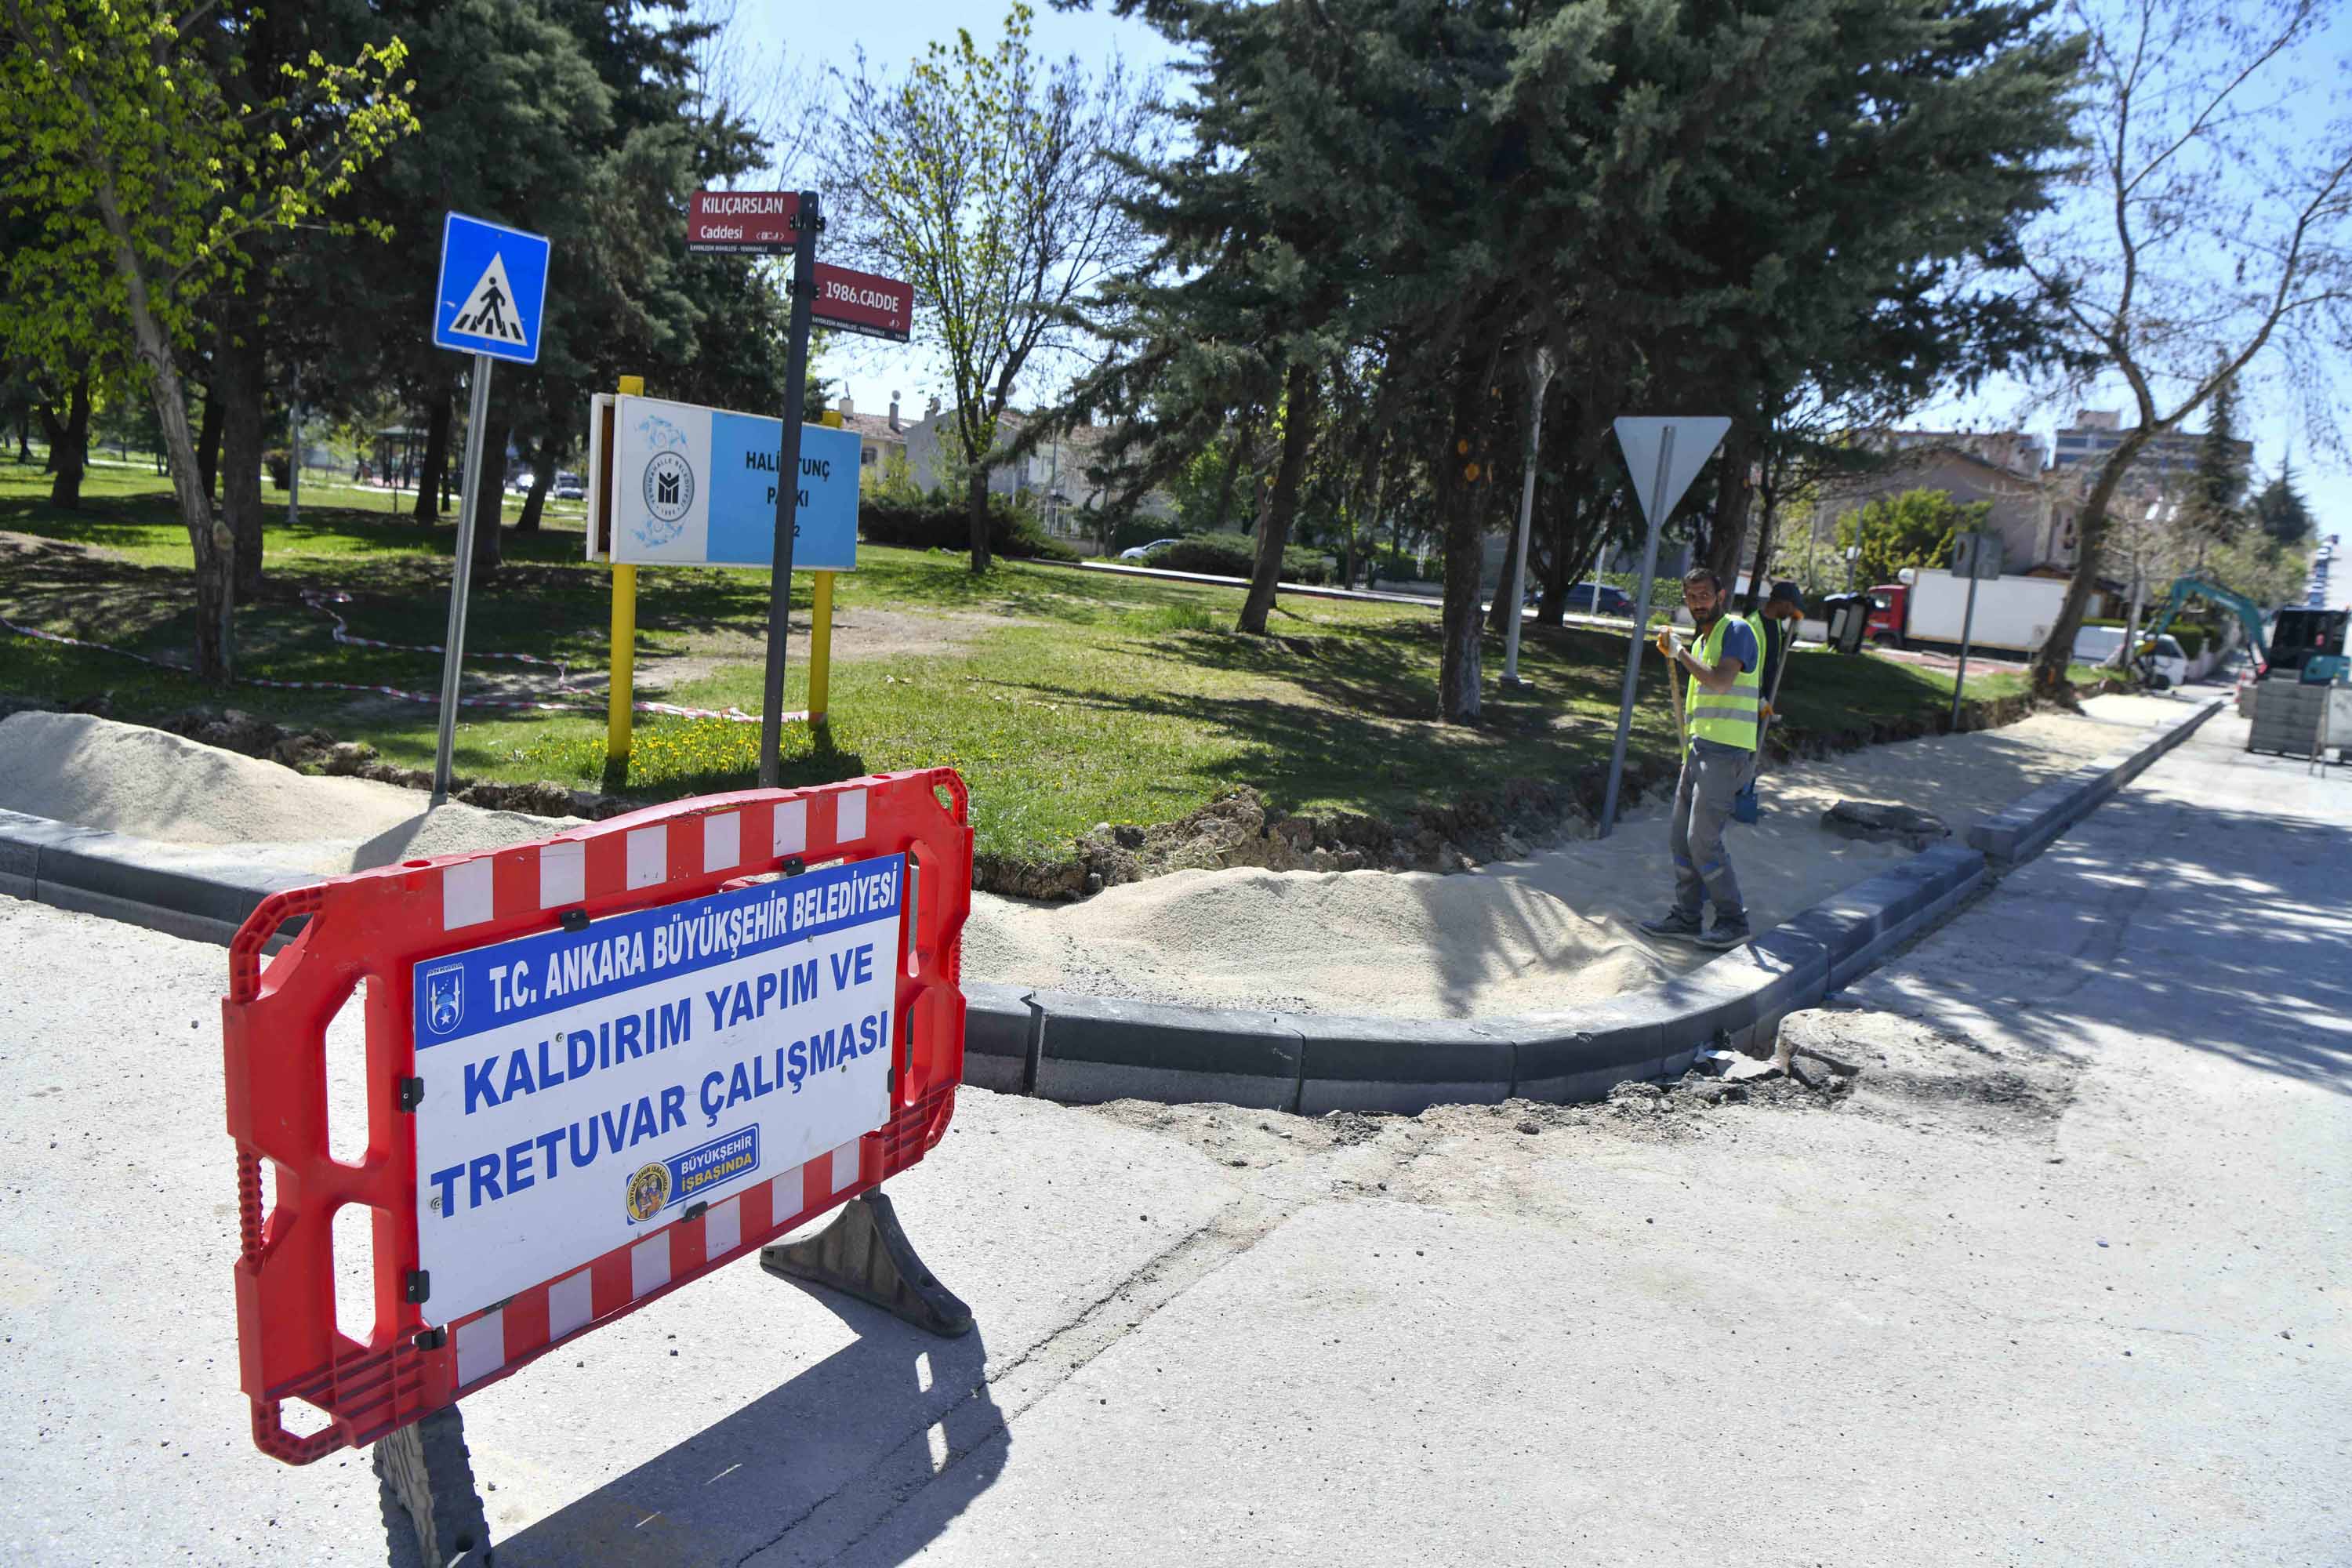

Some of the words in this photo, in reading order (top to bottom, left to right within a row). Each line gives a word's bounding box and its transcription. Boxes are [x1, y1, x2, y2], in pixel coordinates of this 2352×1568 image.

[702, 197, 783, 216] KILIÇARSLAN
[700, 225, 742, 239] Caddesi
[826, 281, 899, 313] 1986.CADDE
[746, 451, 781, 472] HALİ
[767, 486, 809, 507] PKI
[489, 960, 537, 1013] T.C.
[544, 931, 646, 1000] ANKARA
[652, 890, 788, 959] BÜYÜKŞEHİR
[792, 862, 898, 931] BELEDİYESİ
[463, 997, 691, 1115] KALDIRIM
[706, 958, 818, 1033] YAPIM
[829, 942, 873, 992] VE
[430, 1085, 687, 1218] TRETUVAR
[700, 1010, 887, 1128] ÇALIŞMASI
[681, 1135, 753, 1174] BÜYÜKŞEHİR
[681, 1152, 753, 1192] İŞBAŞINDA
